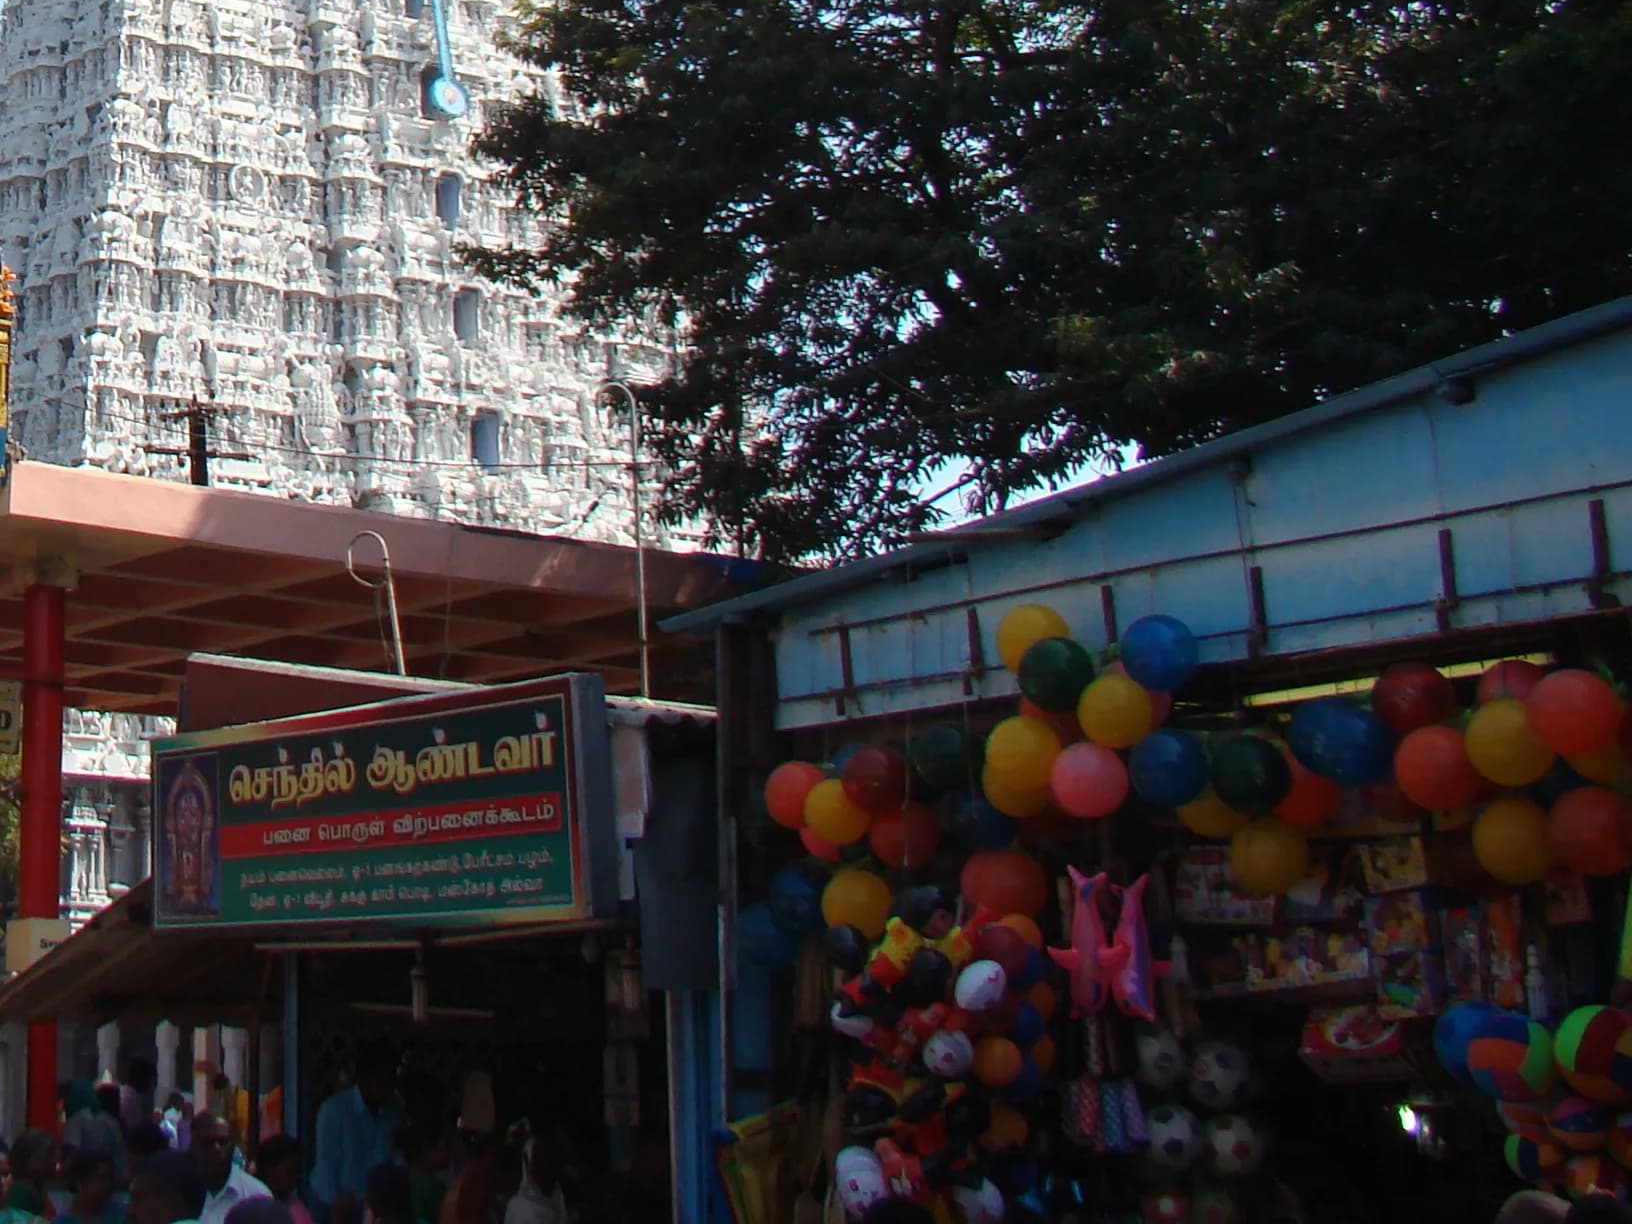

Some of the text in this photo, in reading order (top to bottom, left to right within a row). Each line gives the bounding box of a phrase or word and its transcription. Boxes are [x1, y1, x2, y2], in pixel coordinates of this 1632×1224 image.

[230, 708, 556, 810] செந்தில் ஆண்டவர்
[263, 798, 555, 844] பனை பொருள் விற்பனைக்கூடம்
